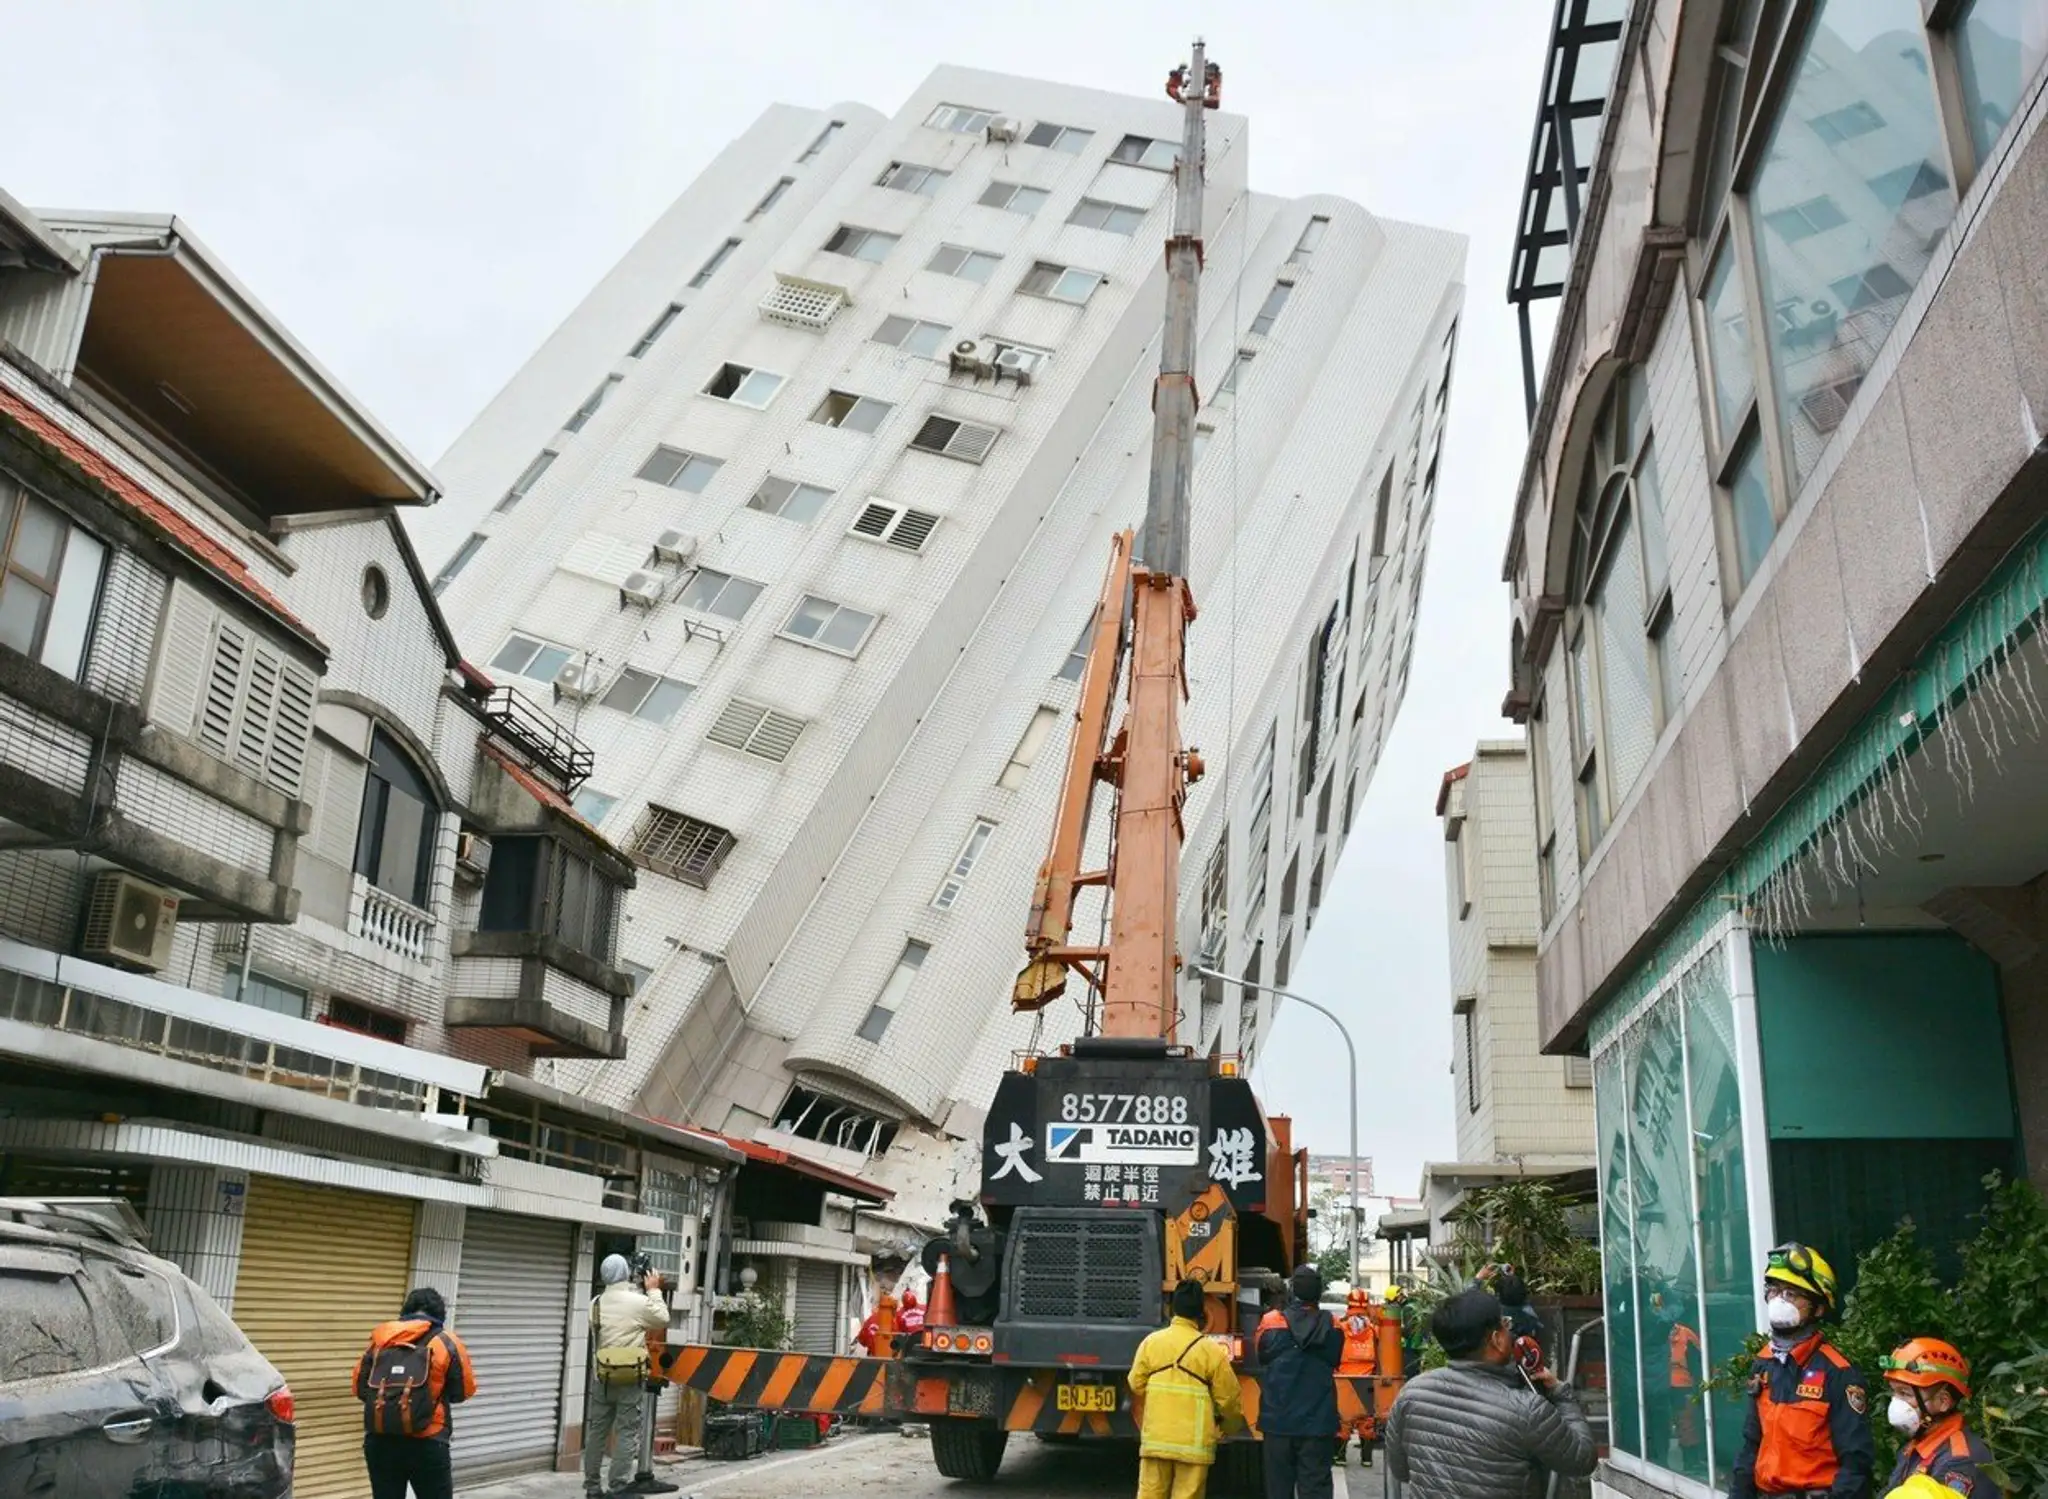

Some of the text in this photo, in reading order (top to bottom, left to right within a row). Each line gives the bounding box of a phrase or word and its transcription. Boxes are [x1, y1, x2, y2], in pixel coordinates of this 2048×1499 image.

[1061, 1093, 1188, 1124] 8577888
[1107, 1129, 1194, 1147] TADANO
[990, 1121, 1263, 1190] 大 雄
[1084, 1184, 1160, 1203] 禁止靠近
